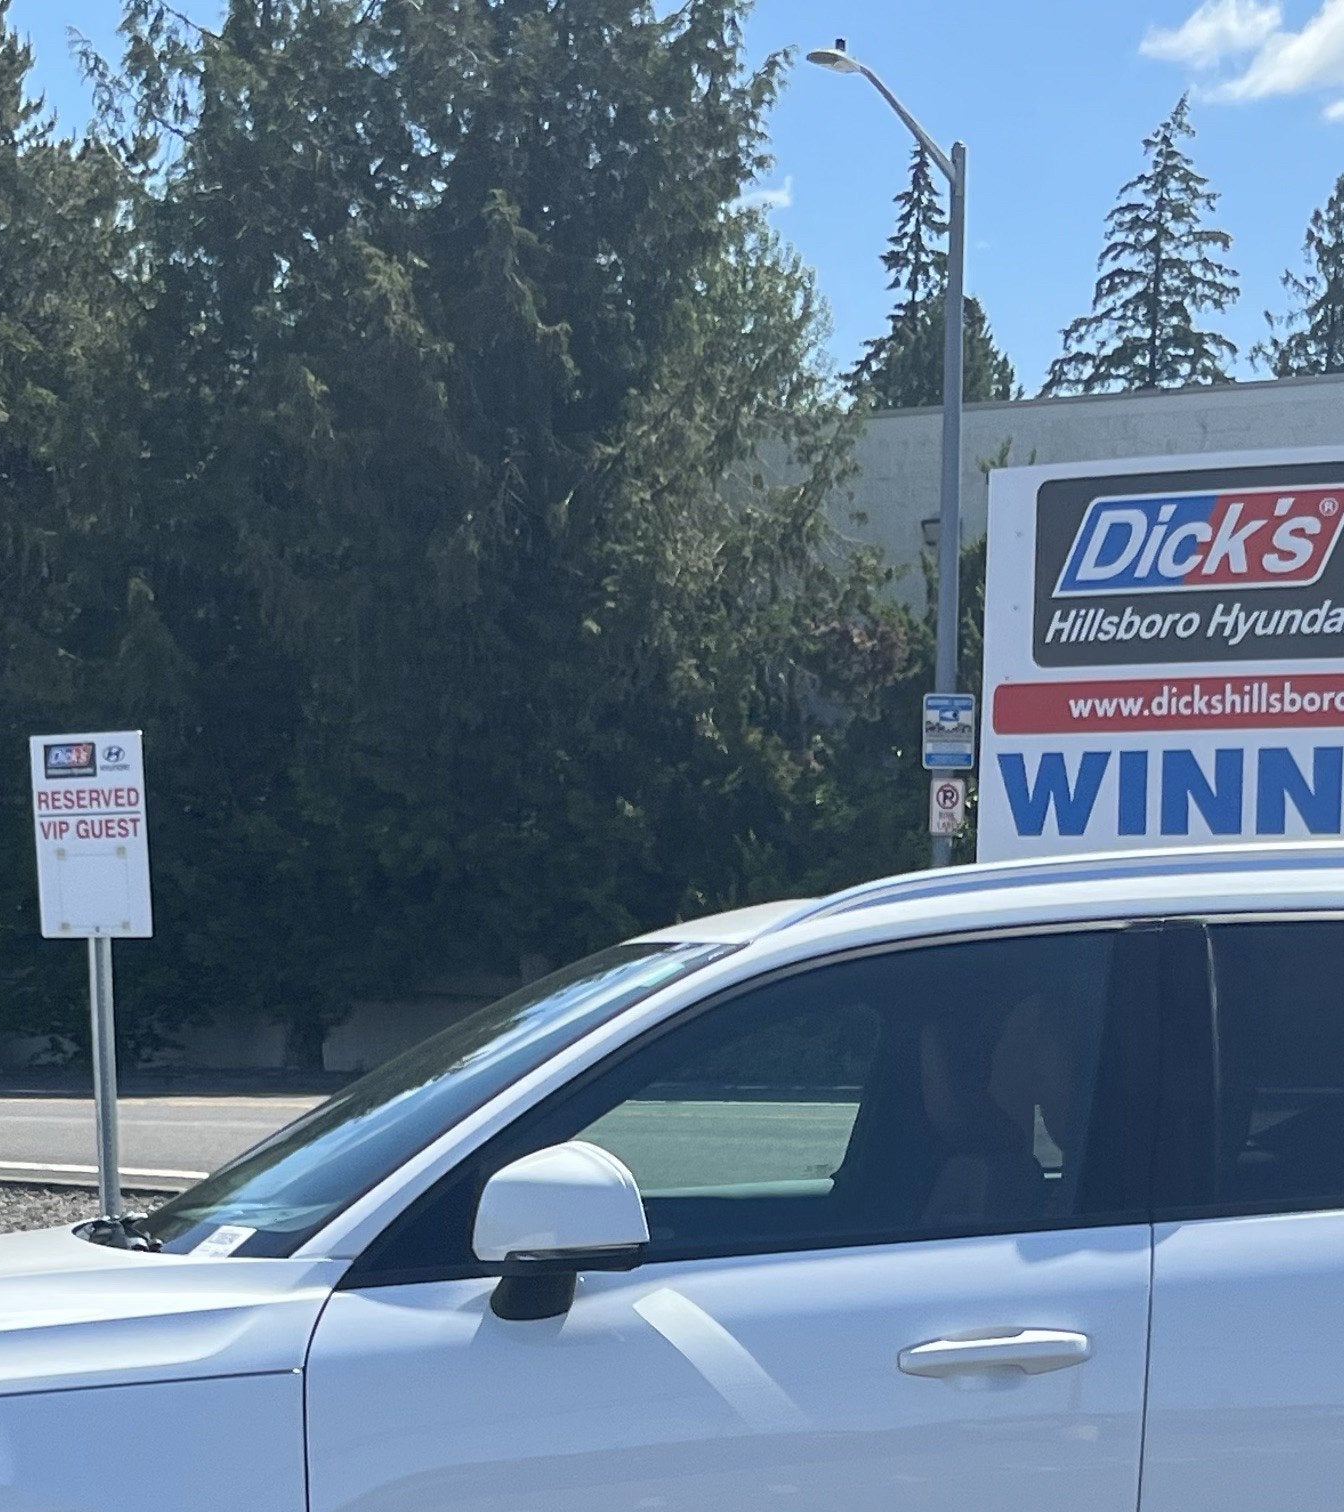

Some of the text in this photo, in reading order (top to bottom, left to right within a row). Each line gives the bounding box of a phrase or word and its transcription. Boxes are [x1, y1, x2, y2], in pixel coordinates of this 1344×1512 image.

[1075, 497, 1321, 581] Dick's
[1044, 606, 1201, 643] Hillsboro
[37, 788, 139, 811] RESERVED
[40, 818, 141, 840] VIP GUEST
